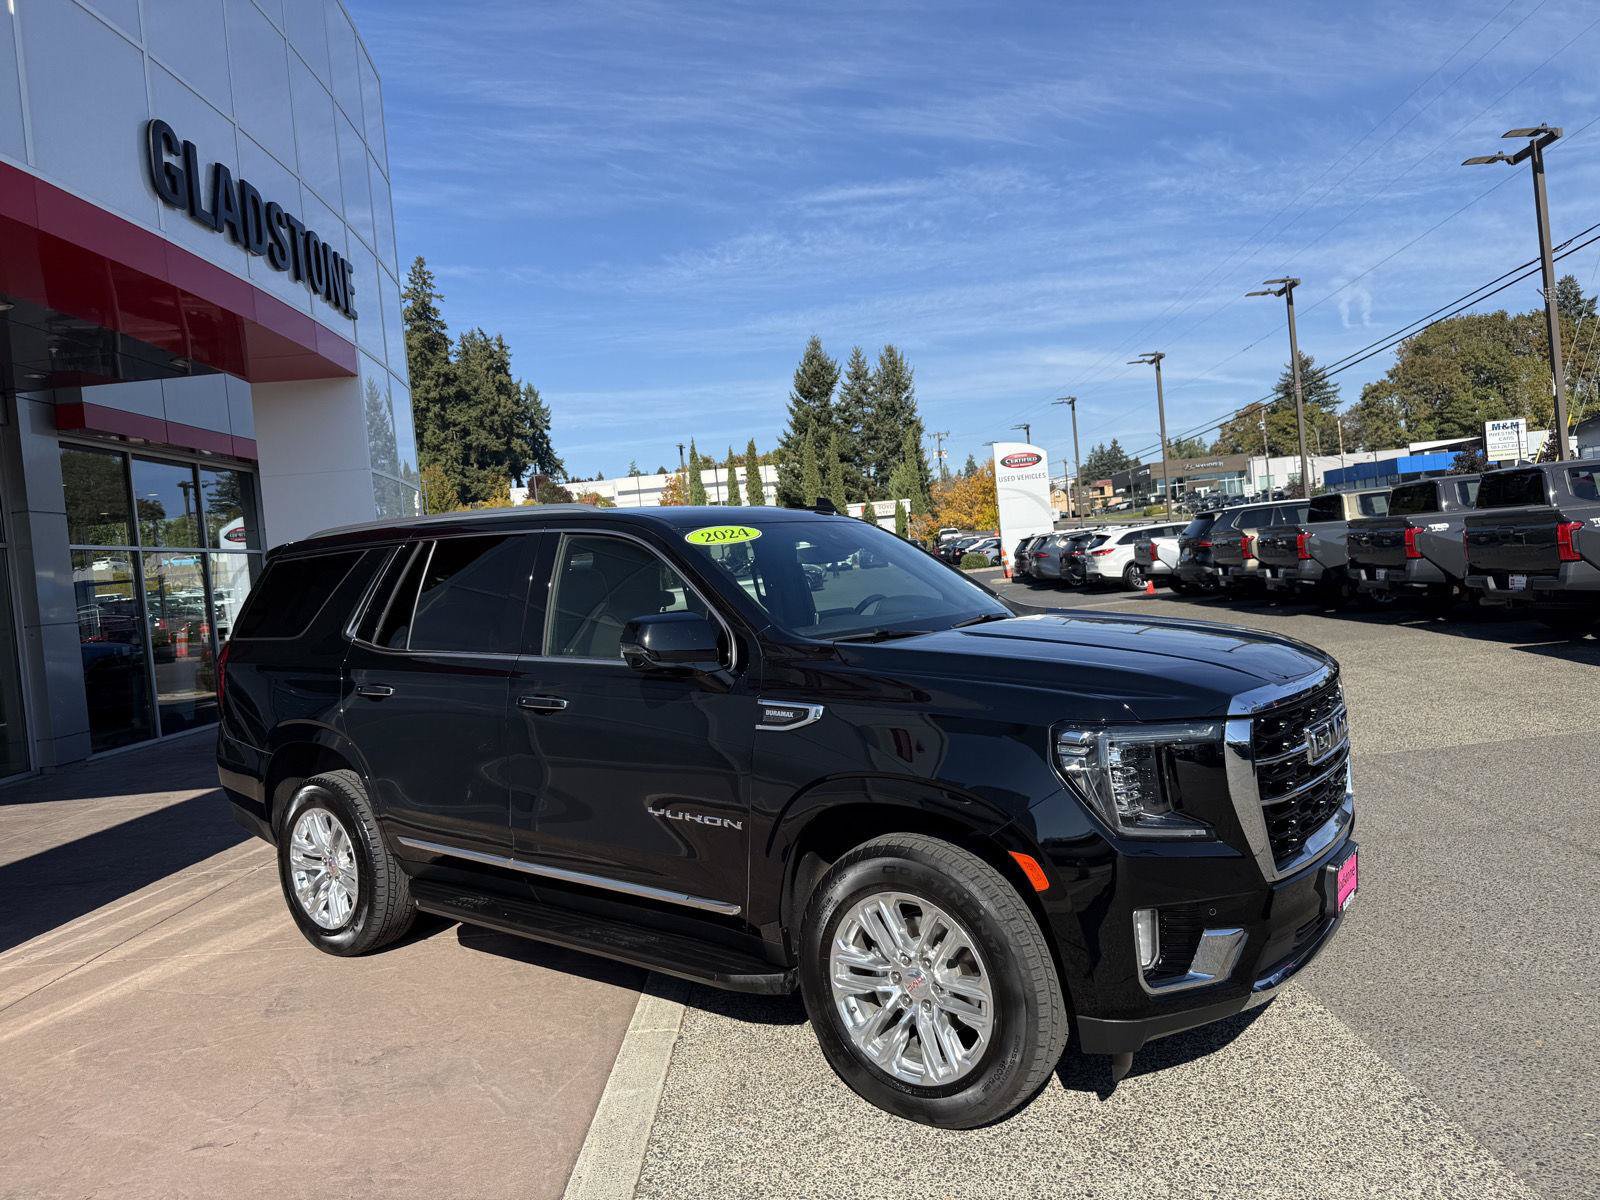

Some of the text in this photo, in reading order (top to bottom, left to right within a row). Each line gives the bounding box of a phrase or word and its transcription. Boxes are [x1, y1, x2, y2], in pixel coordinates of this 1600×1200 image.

[147, 118, 358, 320] GLADSTONE
[1491, 421, 1519, 431] M&M
[1017, 473, 1046, 481] VEHICLES
[701, 528, 750, 543] 2024
[765, 709, 794, 718] DURAMAX
[647, 806, 743, 831] YUKON
